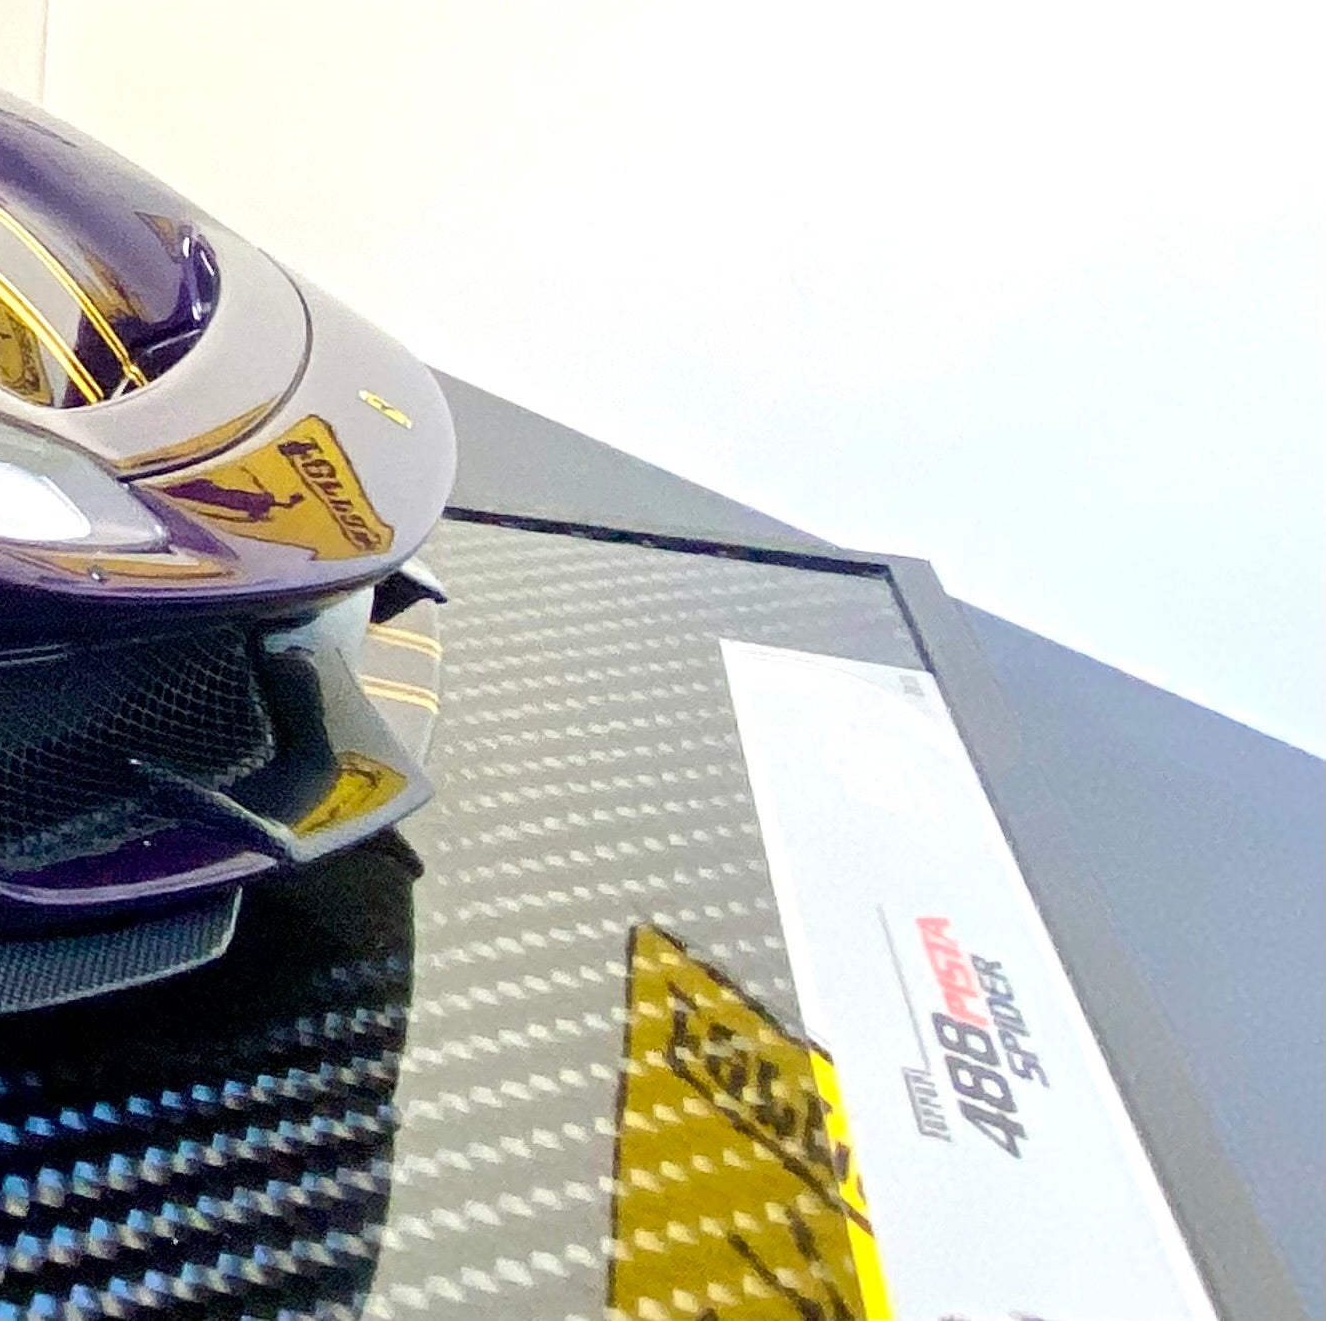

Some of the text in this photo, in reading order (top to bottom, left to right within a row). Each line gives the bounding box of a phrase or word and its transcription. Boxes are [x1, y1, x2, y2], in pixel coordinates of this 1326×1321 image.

[915, 916, 1029, 1160] 488 PISTA
[970, 953, 1051, 1089] SPIDER
